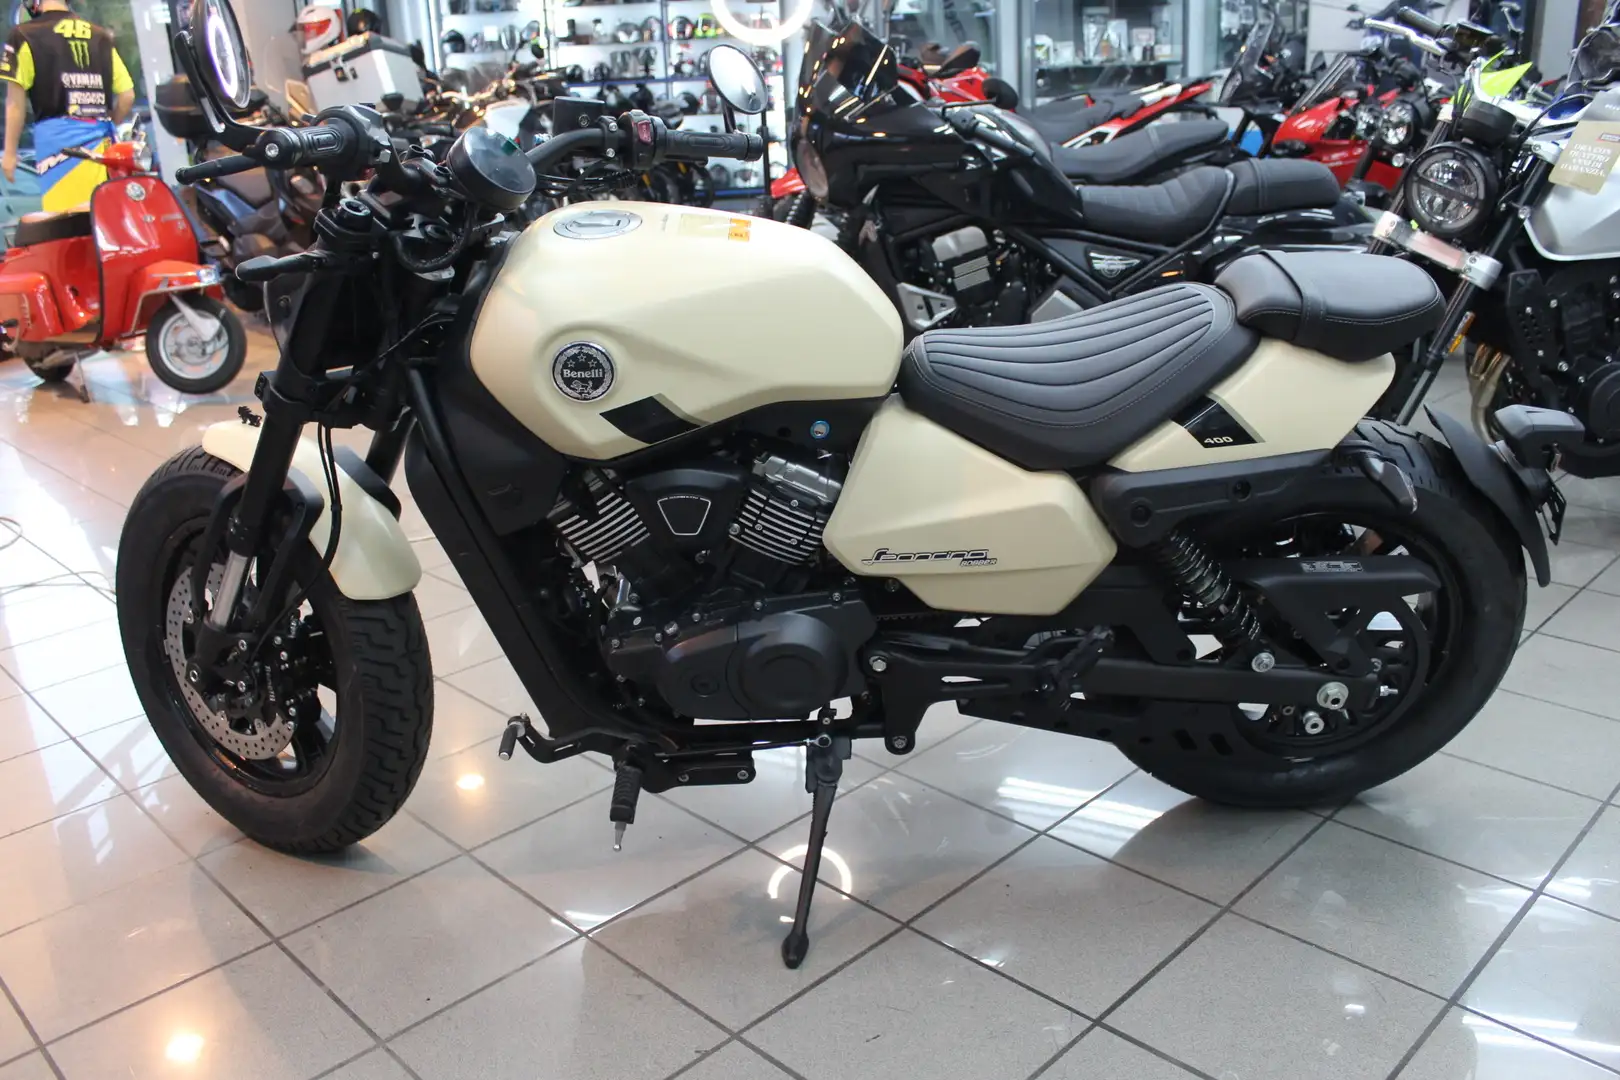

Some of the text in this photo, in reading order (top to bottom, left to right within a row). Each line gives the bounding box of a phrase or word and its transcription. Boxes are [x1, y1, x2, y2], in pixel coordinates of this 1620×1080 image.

[53, 19, 92, 39] 46
[562, 368, 604, 378] Benelli
[1203, 436, 1234, 444] 400
